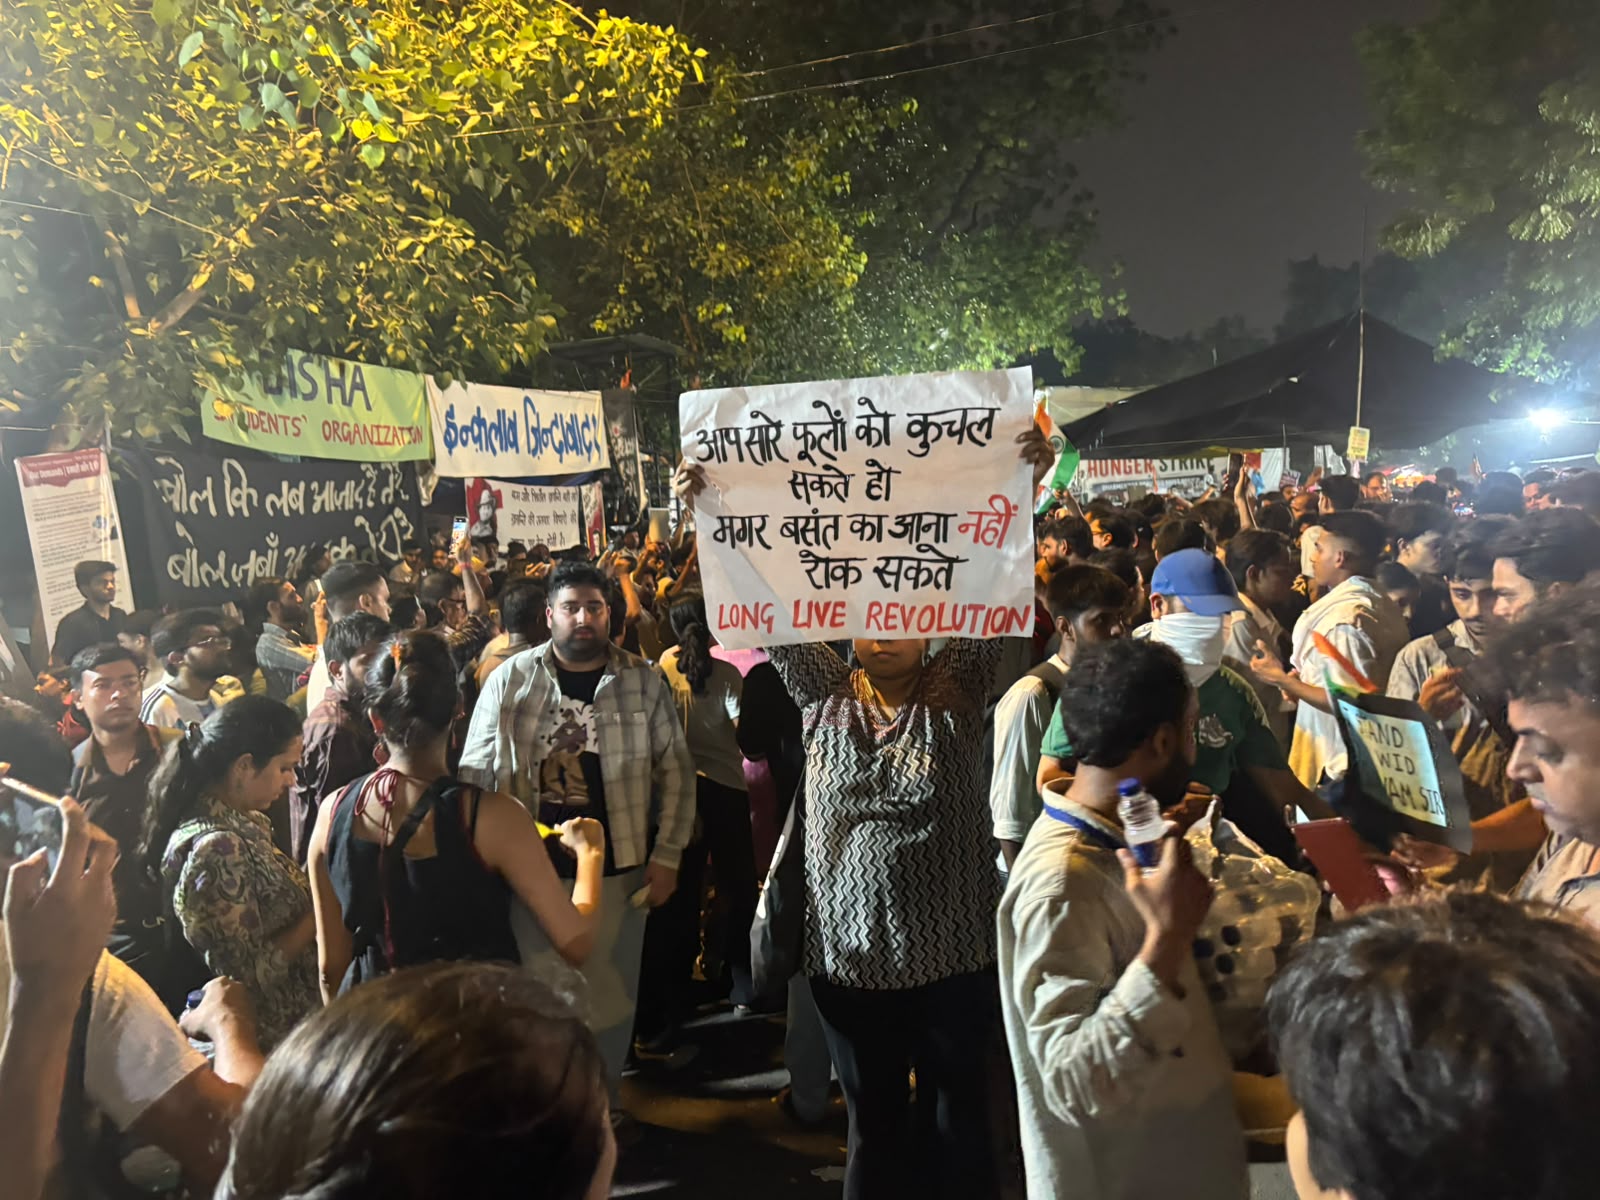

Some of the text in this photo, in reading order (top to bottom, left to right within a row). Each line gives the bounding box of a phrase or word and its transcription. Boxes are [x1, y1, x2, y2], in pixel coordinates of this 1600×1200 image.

[696, 397, 1001, 466] आप सारे फूलों को कुचल
[788, 459, 901, 505] सकते हो
[1087, 458, 1155, 478] HUNGER
[265, 480, 305, 517] लब
[713, 494, 1018, 550] मगर बसंत का आना नहीं
[167, 520, 230, 588] बोल
[799, 543, 969, 592] रोक सकते
[718, 599, 1032, 637] LONG LIVE REVOLUTION
[1377, 751, 1416, 776] WID
[1420, 786, 1445, 815] SIR
